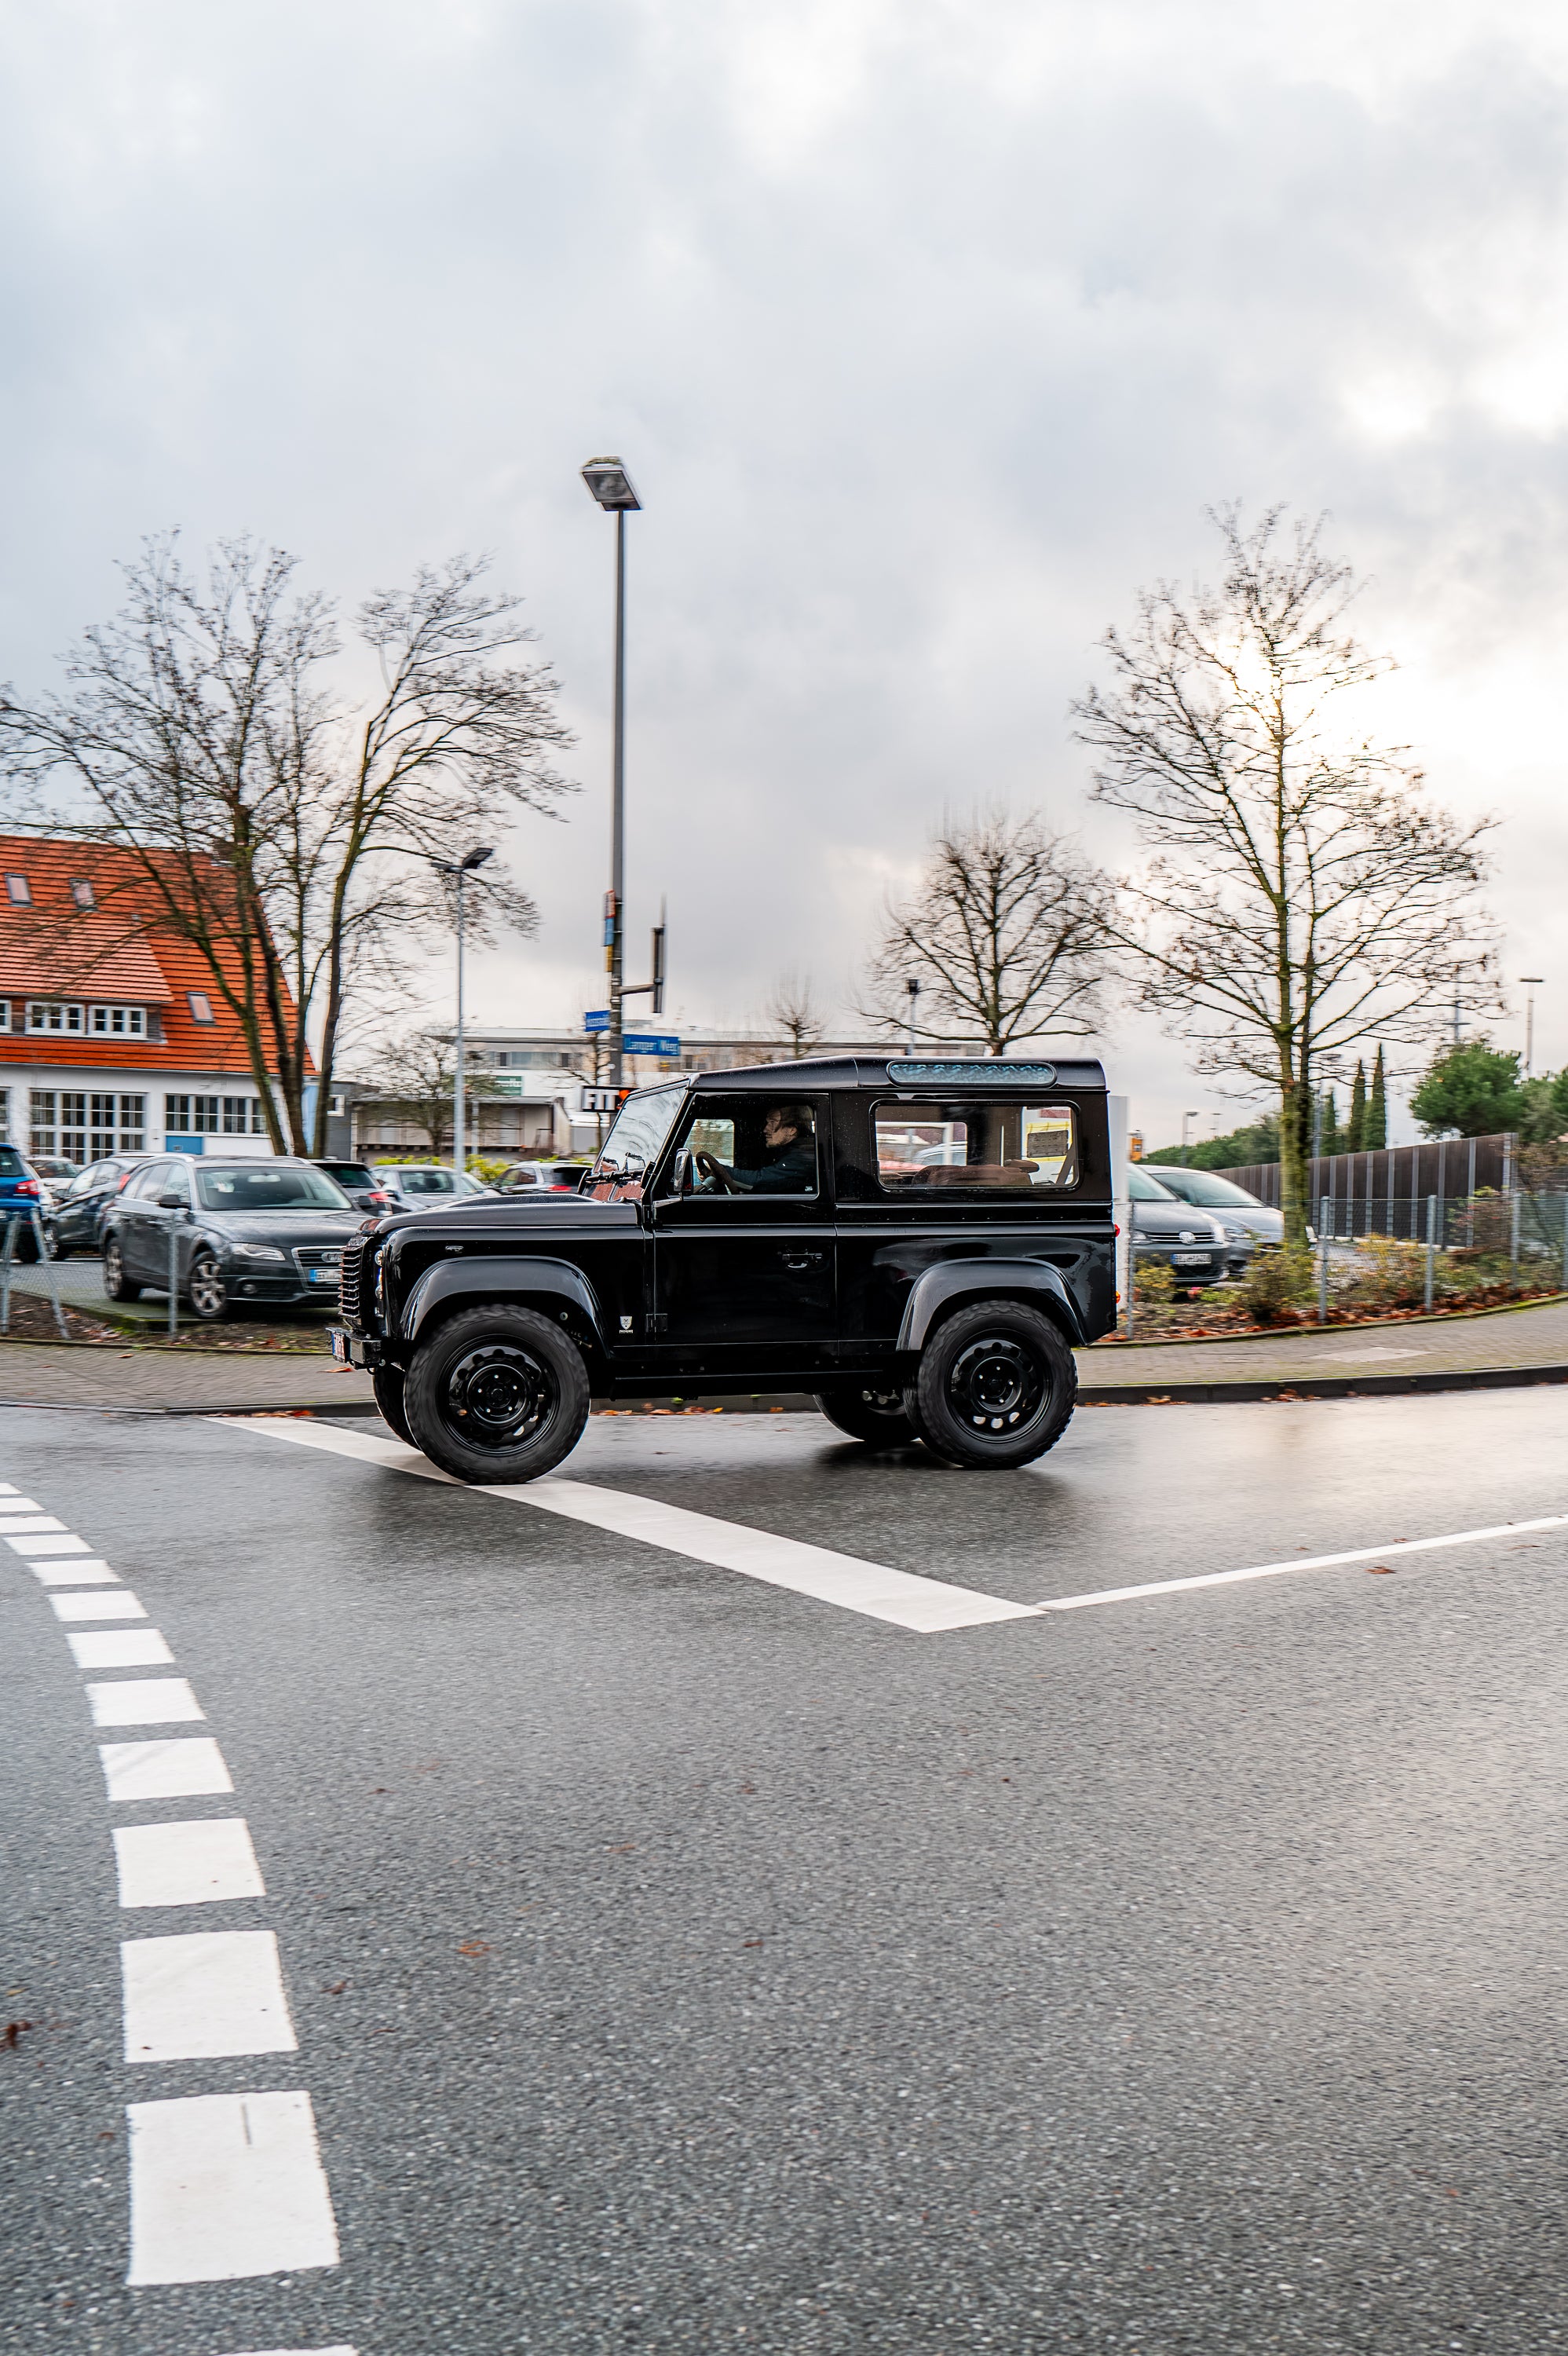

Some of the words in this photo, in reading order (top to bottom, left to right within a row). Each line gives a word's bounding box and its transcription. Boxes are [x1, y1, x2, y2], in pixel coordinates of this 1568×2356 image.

[624, 1037, 656, 1054] Langer
[658, 1040, 678, 1055] Weg
[582, 1088, 620, 1110] FIT
